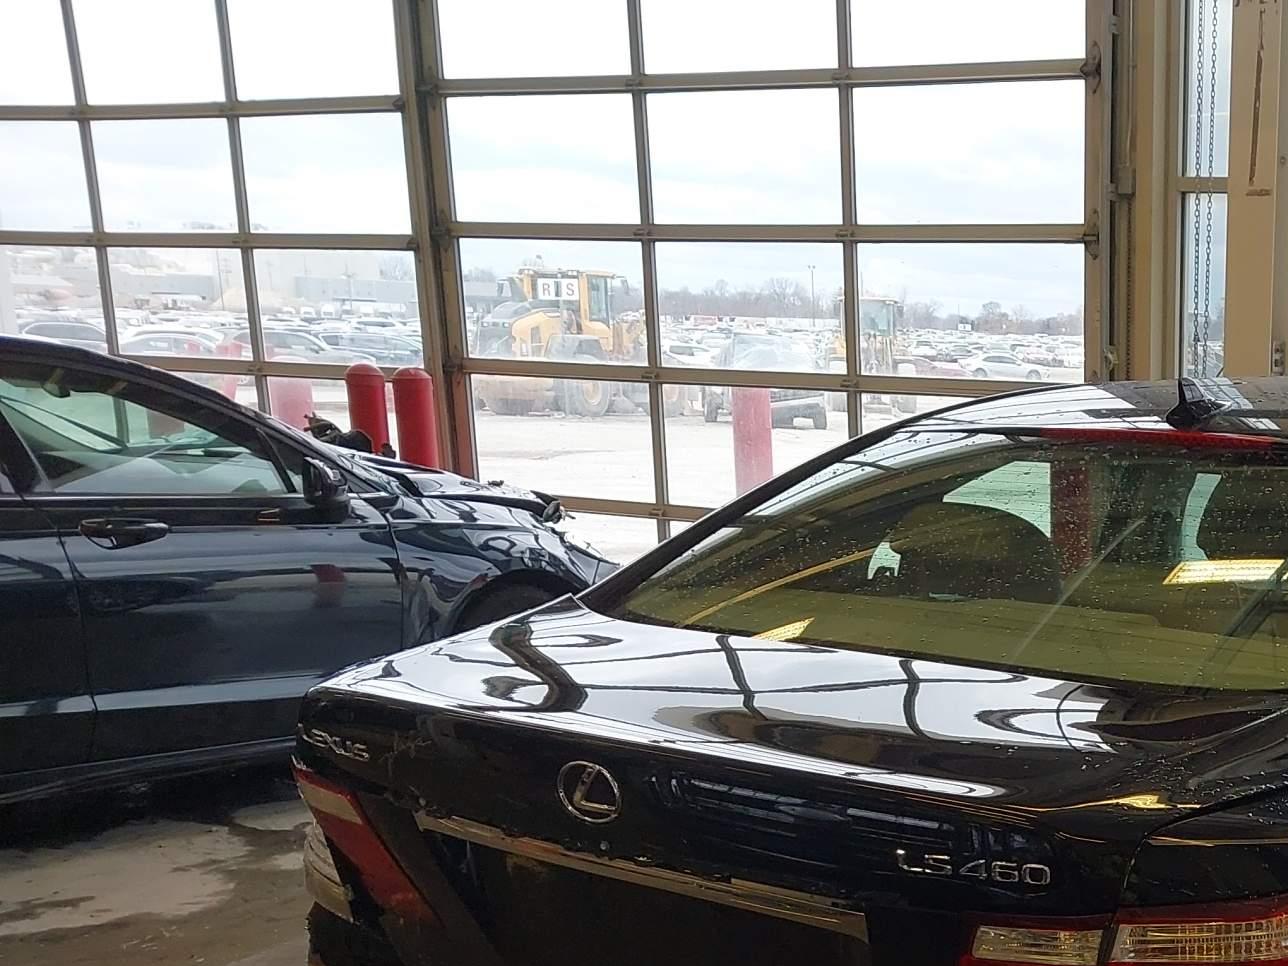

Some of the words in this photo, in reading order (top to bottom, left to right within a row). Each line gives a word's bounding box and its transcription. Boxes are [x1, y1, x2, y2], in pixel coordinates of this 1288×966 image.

[542, 282, 551, 297] R
[566, 282, 575, 297] S
[297, 722, 369, 762] LEXUS
[896, 848, 953, 876] LS
[958, 858, 1051, 886] 460
